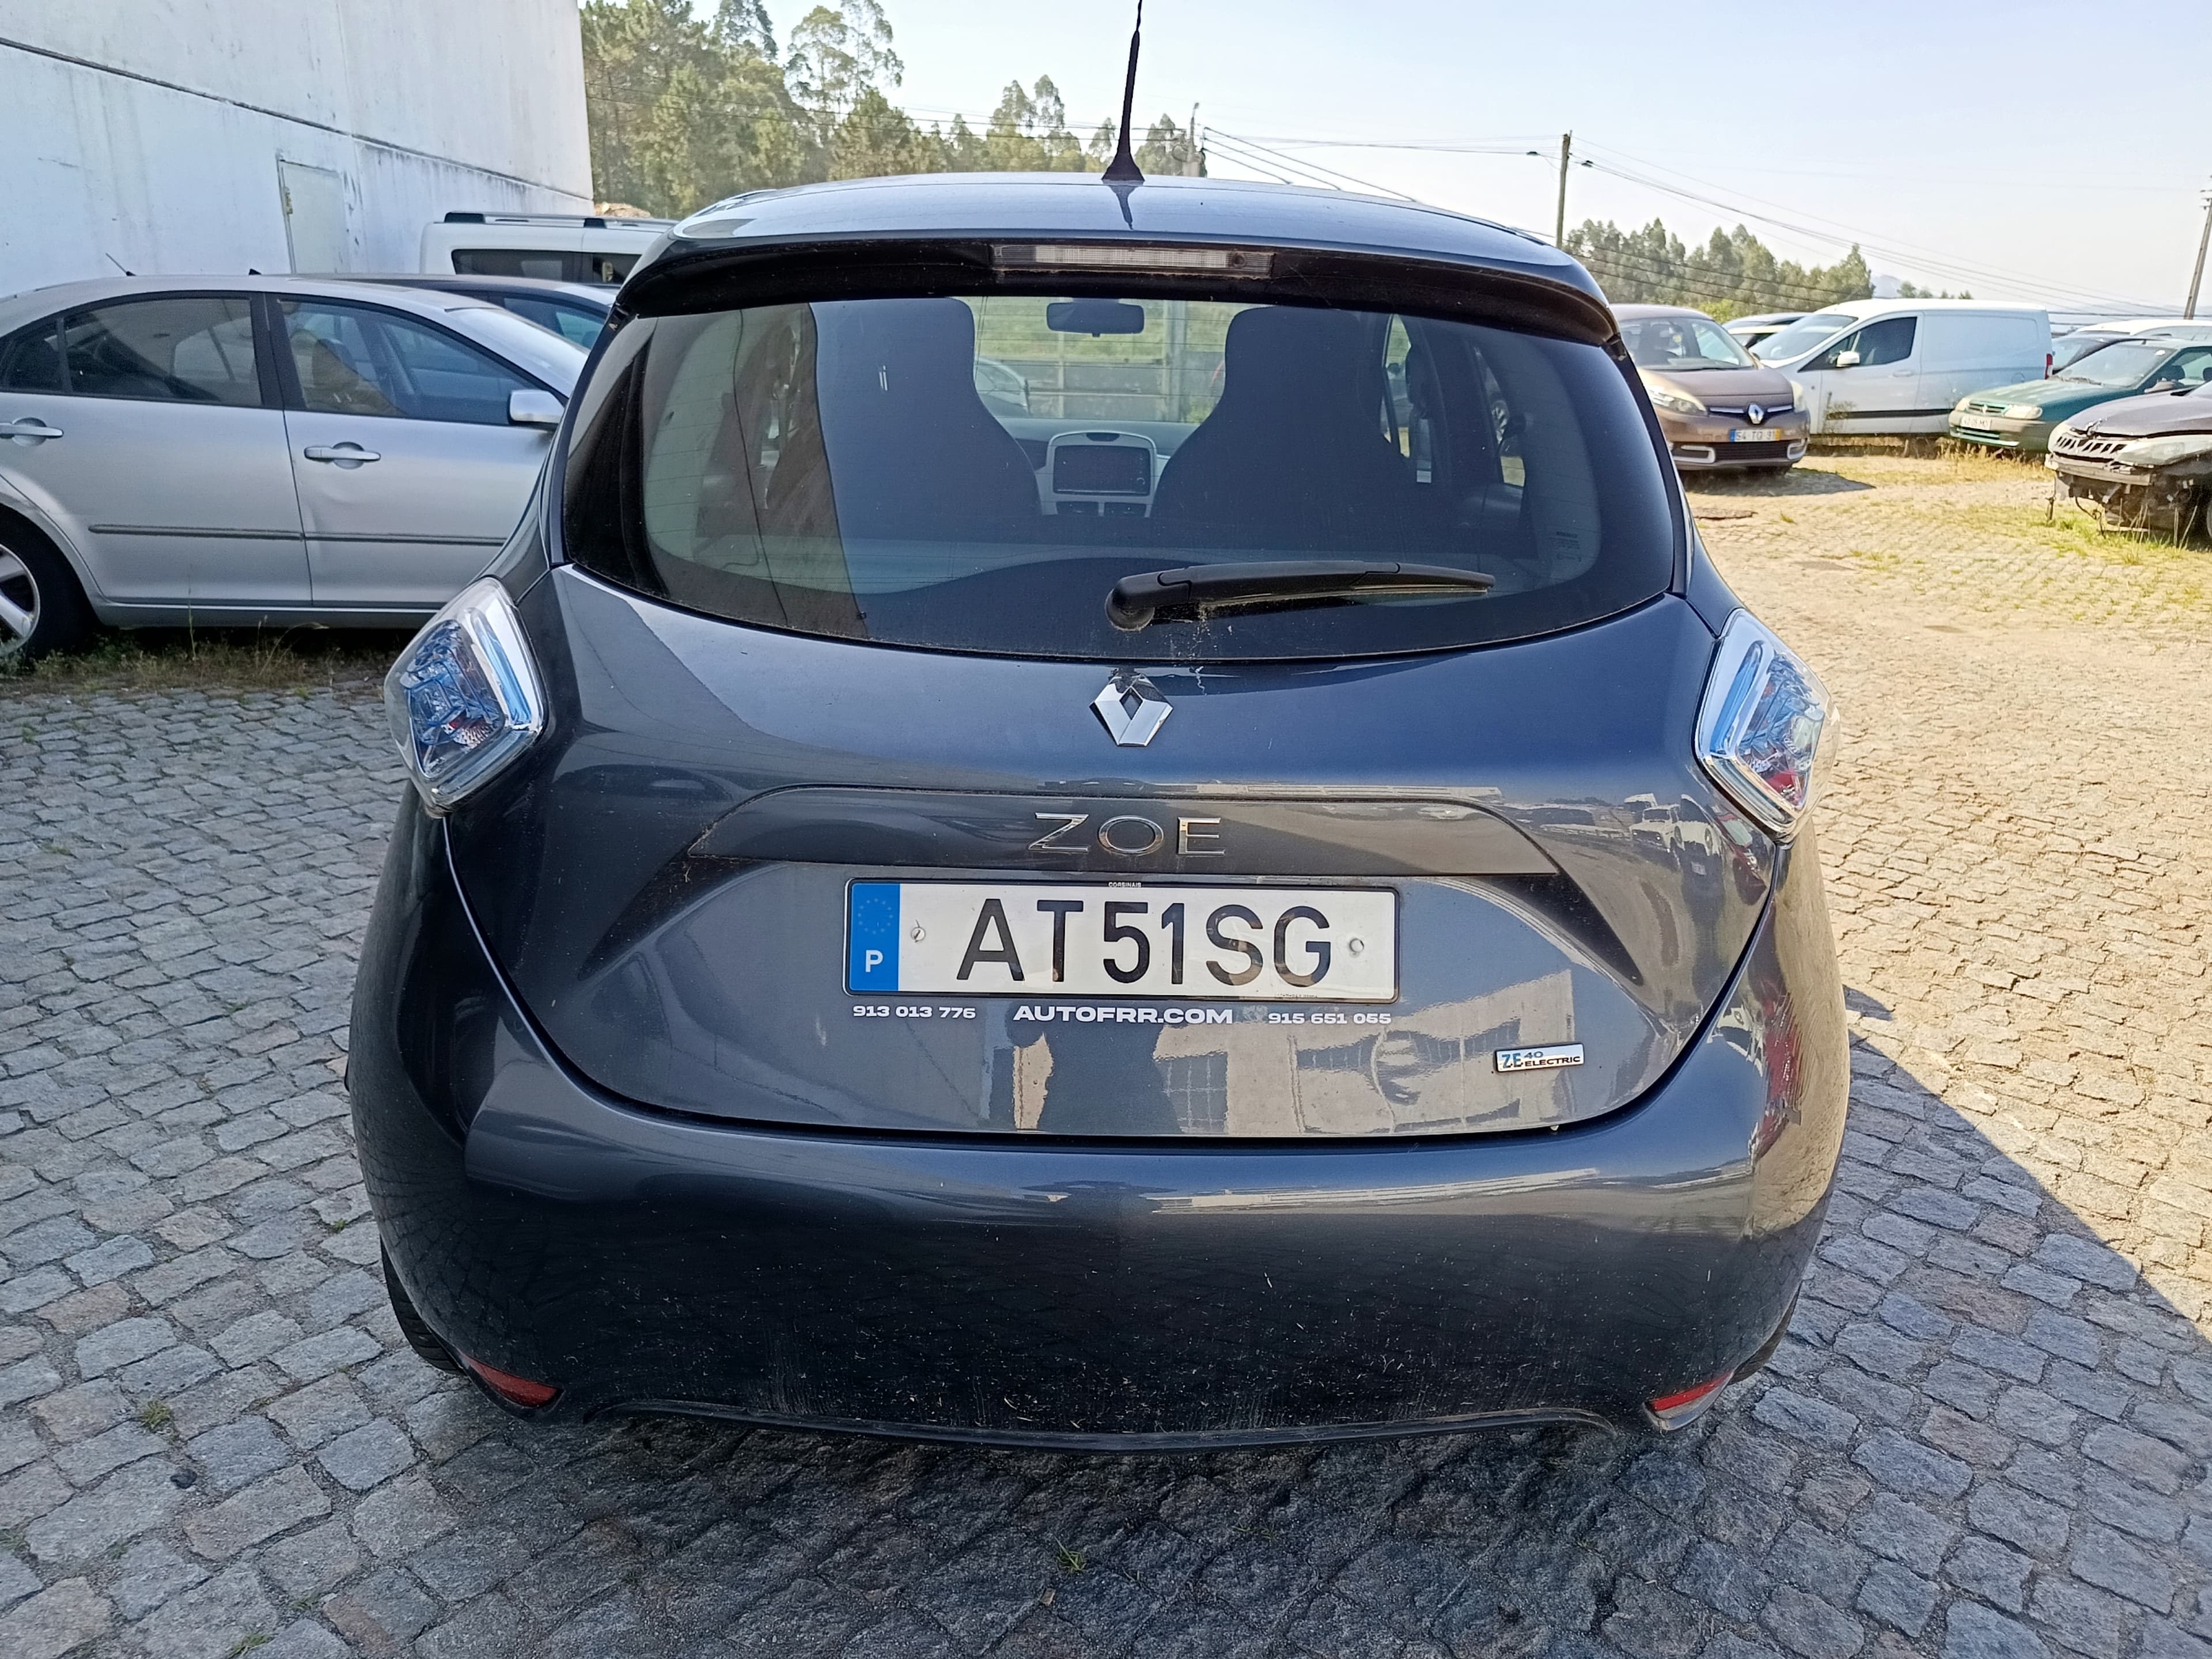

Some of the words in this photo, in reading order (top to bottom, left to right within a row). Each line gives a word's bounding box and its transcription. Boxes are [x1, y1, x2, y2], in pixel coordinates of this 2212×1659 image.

[1028, 812, 1225, 855] ZOE
[865, 949, 883, 972] P
[853, 1005, 889, 1017] 913
[895, 1006, 932, 1018] 013
[939, 1006, 976, 1018] 776
[1013, 1005, 1233, 1024] AUTOFRR.COM
[1268, 1013, 1305, 1024] 915
[1310, 1013, 1347, 1024] 651
[1354, 1013, 1392, 1024] 055
[1525, 1056, 1581, 1067] ELECTRIC
